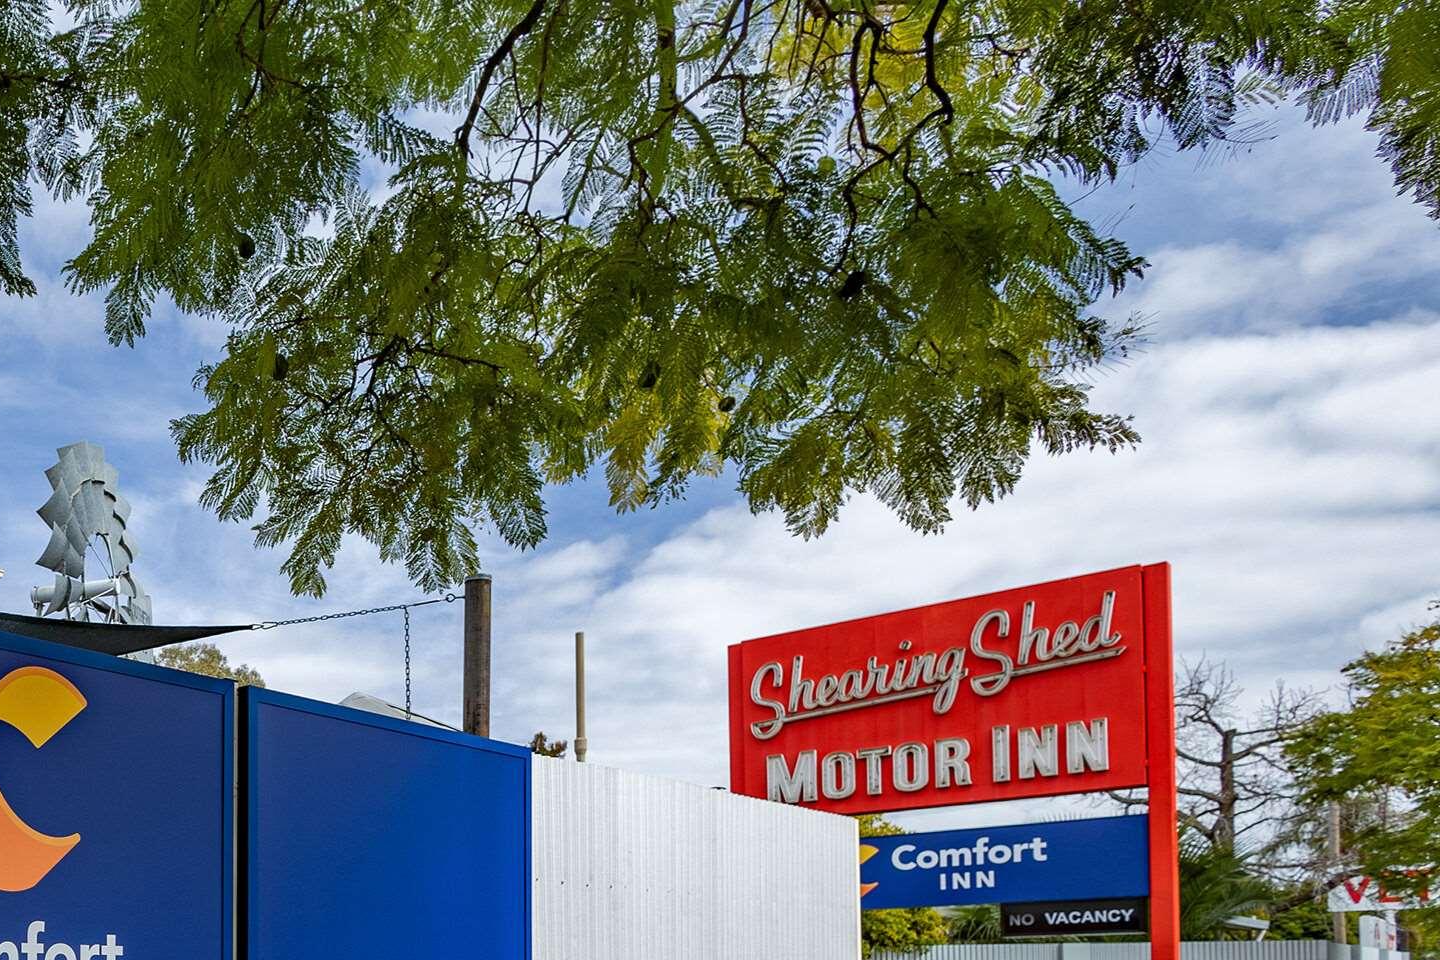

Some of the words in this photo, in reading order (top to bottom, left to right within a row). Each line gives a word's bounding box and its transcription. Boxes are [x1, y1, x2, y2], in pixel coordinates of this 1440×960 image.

[750, 640, 968, 741] Shearing
[970, 590, 1126, 697] Shed
[766, 737, 972, 804] MOTOR
[991, 717, 1110, 783] INN
[891, 837, 1048, 871] Comfort
[939, 870, 995, 890] INN
[1009, 914, 1035, 926] NO
[1044, 908, 1134, 926] VACANCY
